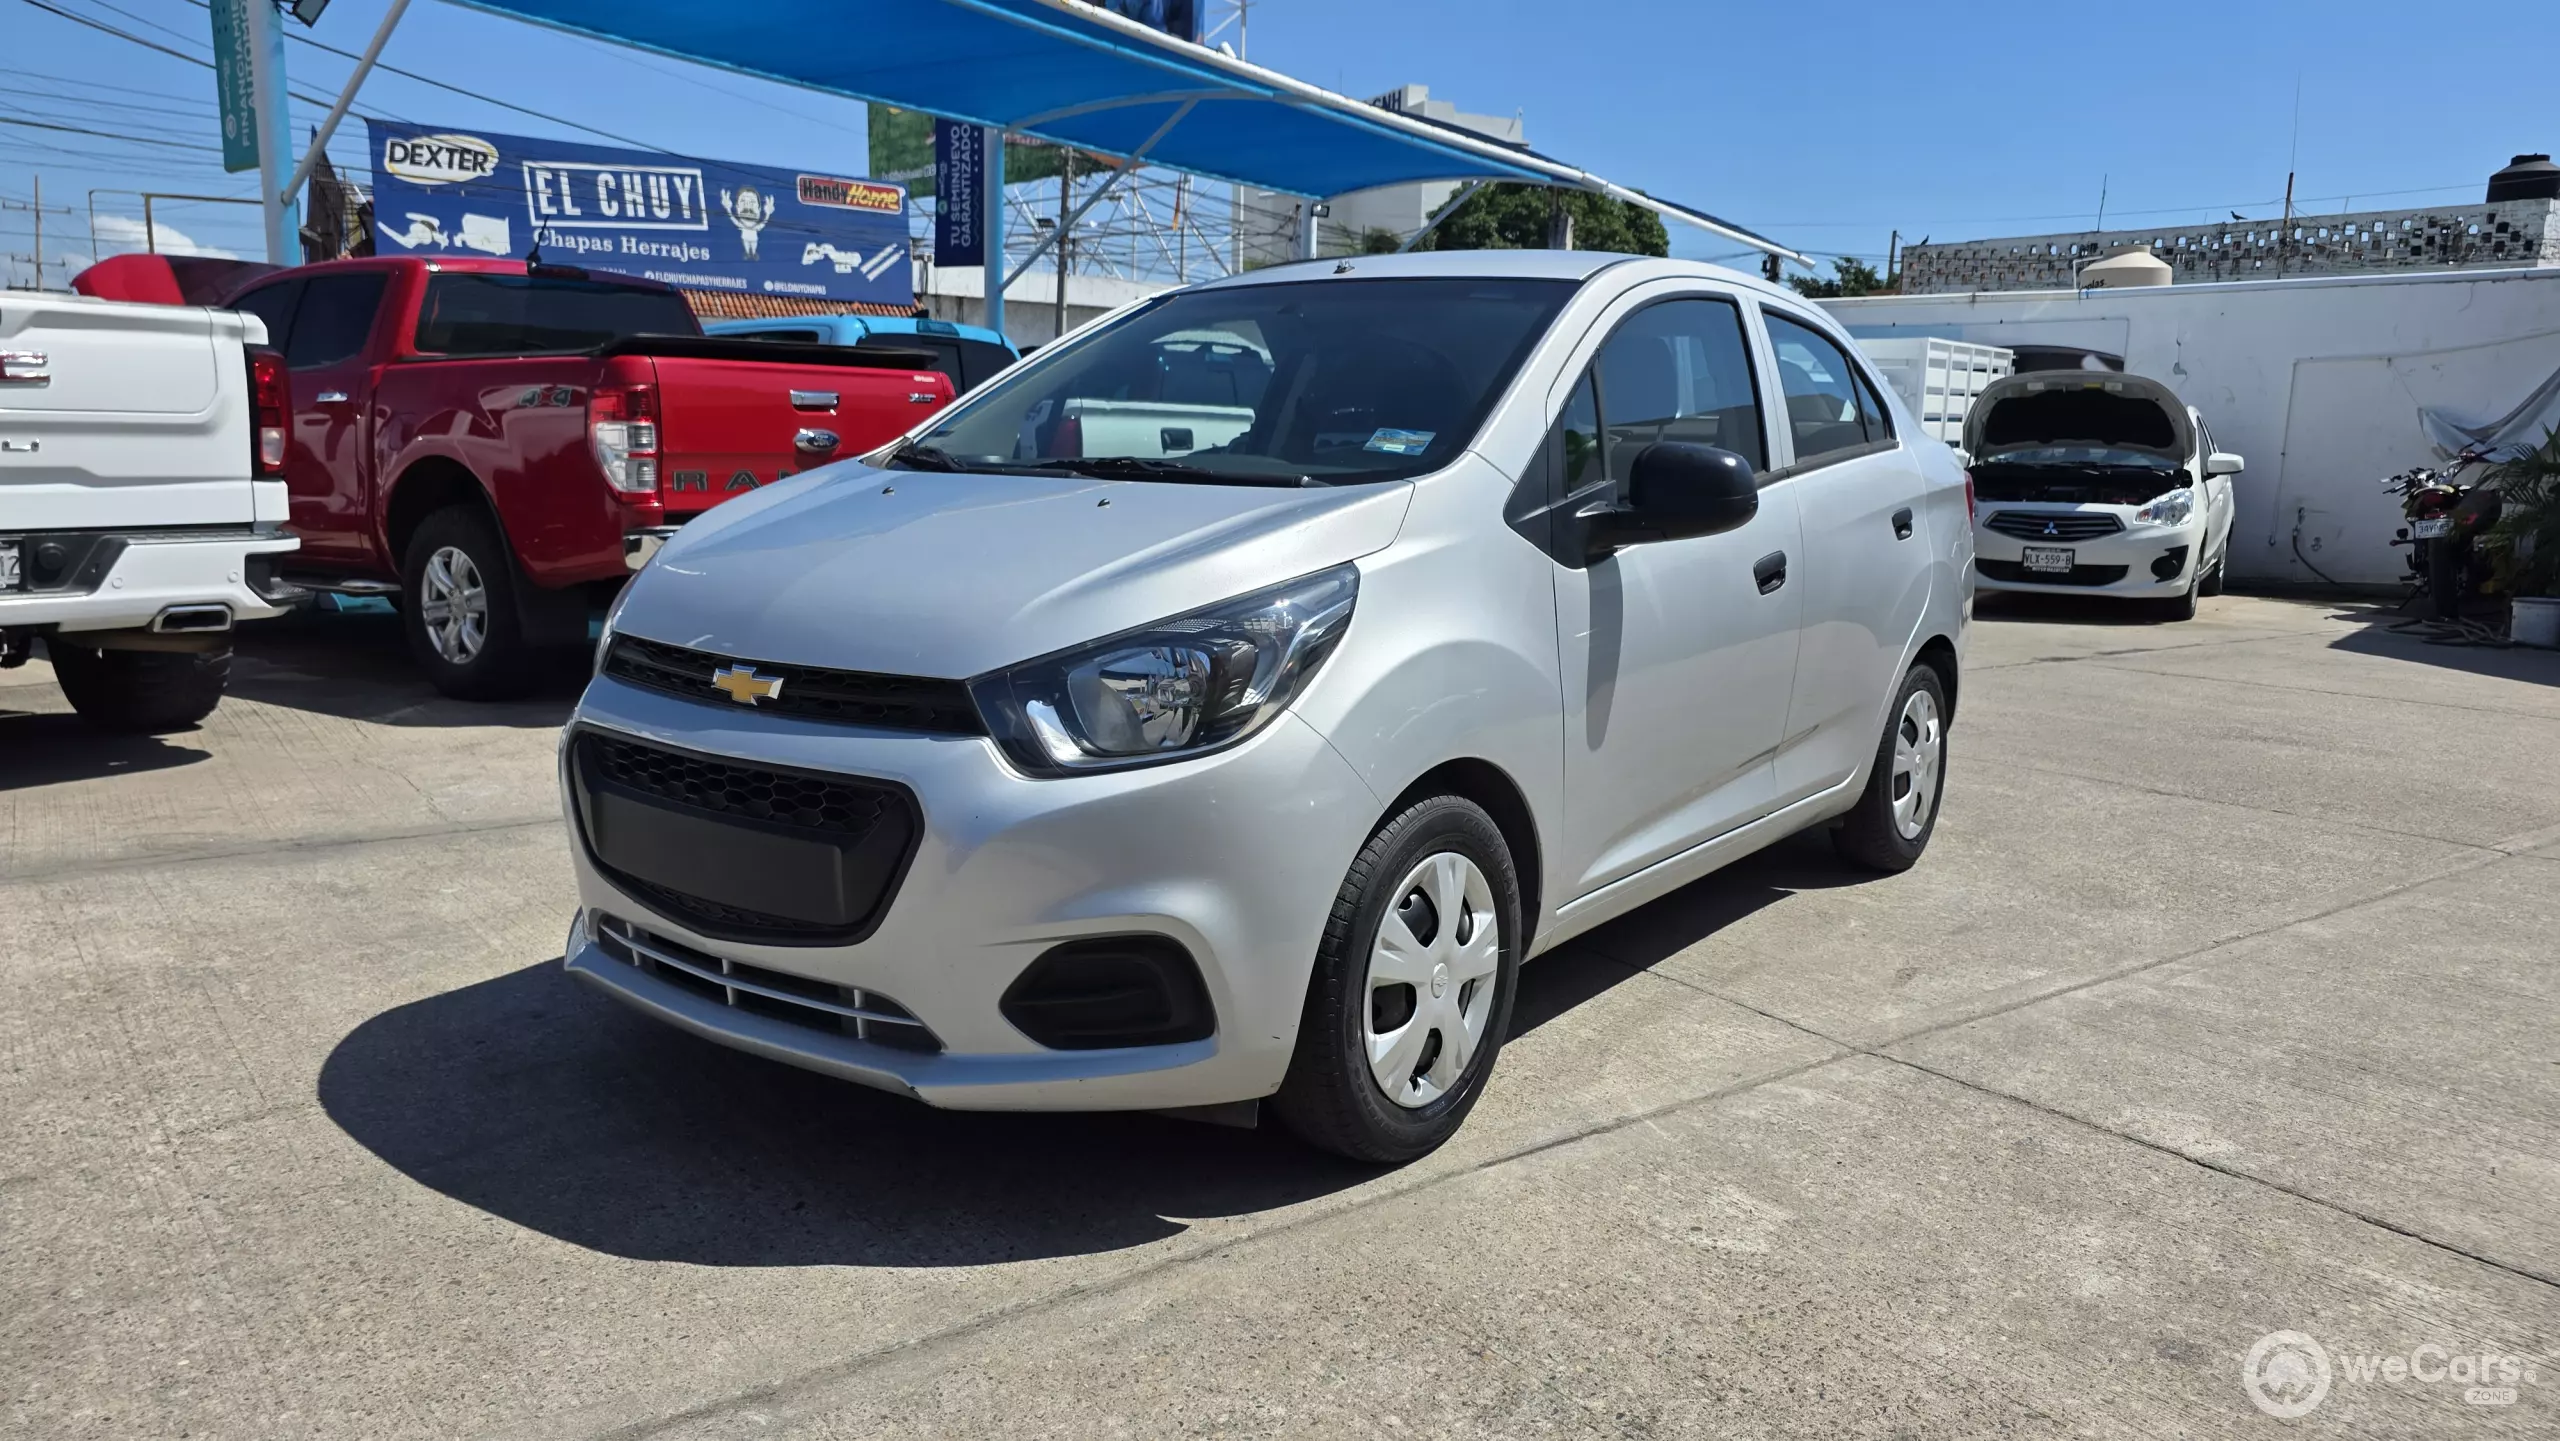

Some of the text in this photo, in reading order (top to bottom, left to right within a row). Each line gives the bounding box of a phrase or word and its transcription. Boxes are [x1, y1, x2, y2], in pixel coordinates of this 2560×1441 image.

[239, 0, 255, 107] AUTOMO
[388, 141, 489, 174] DEXTER
[535, 168, 692, 219] EL CHUY
[950, 125, 961, 247] TU SEMINUEVO
[961, 124, 971, 247] GARANTIZADO
[533, 228, 710, 262] Chapas Herrajes
